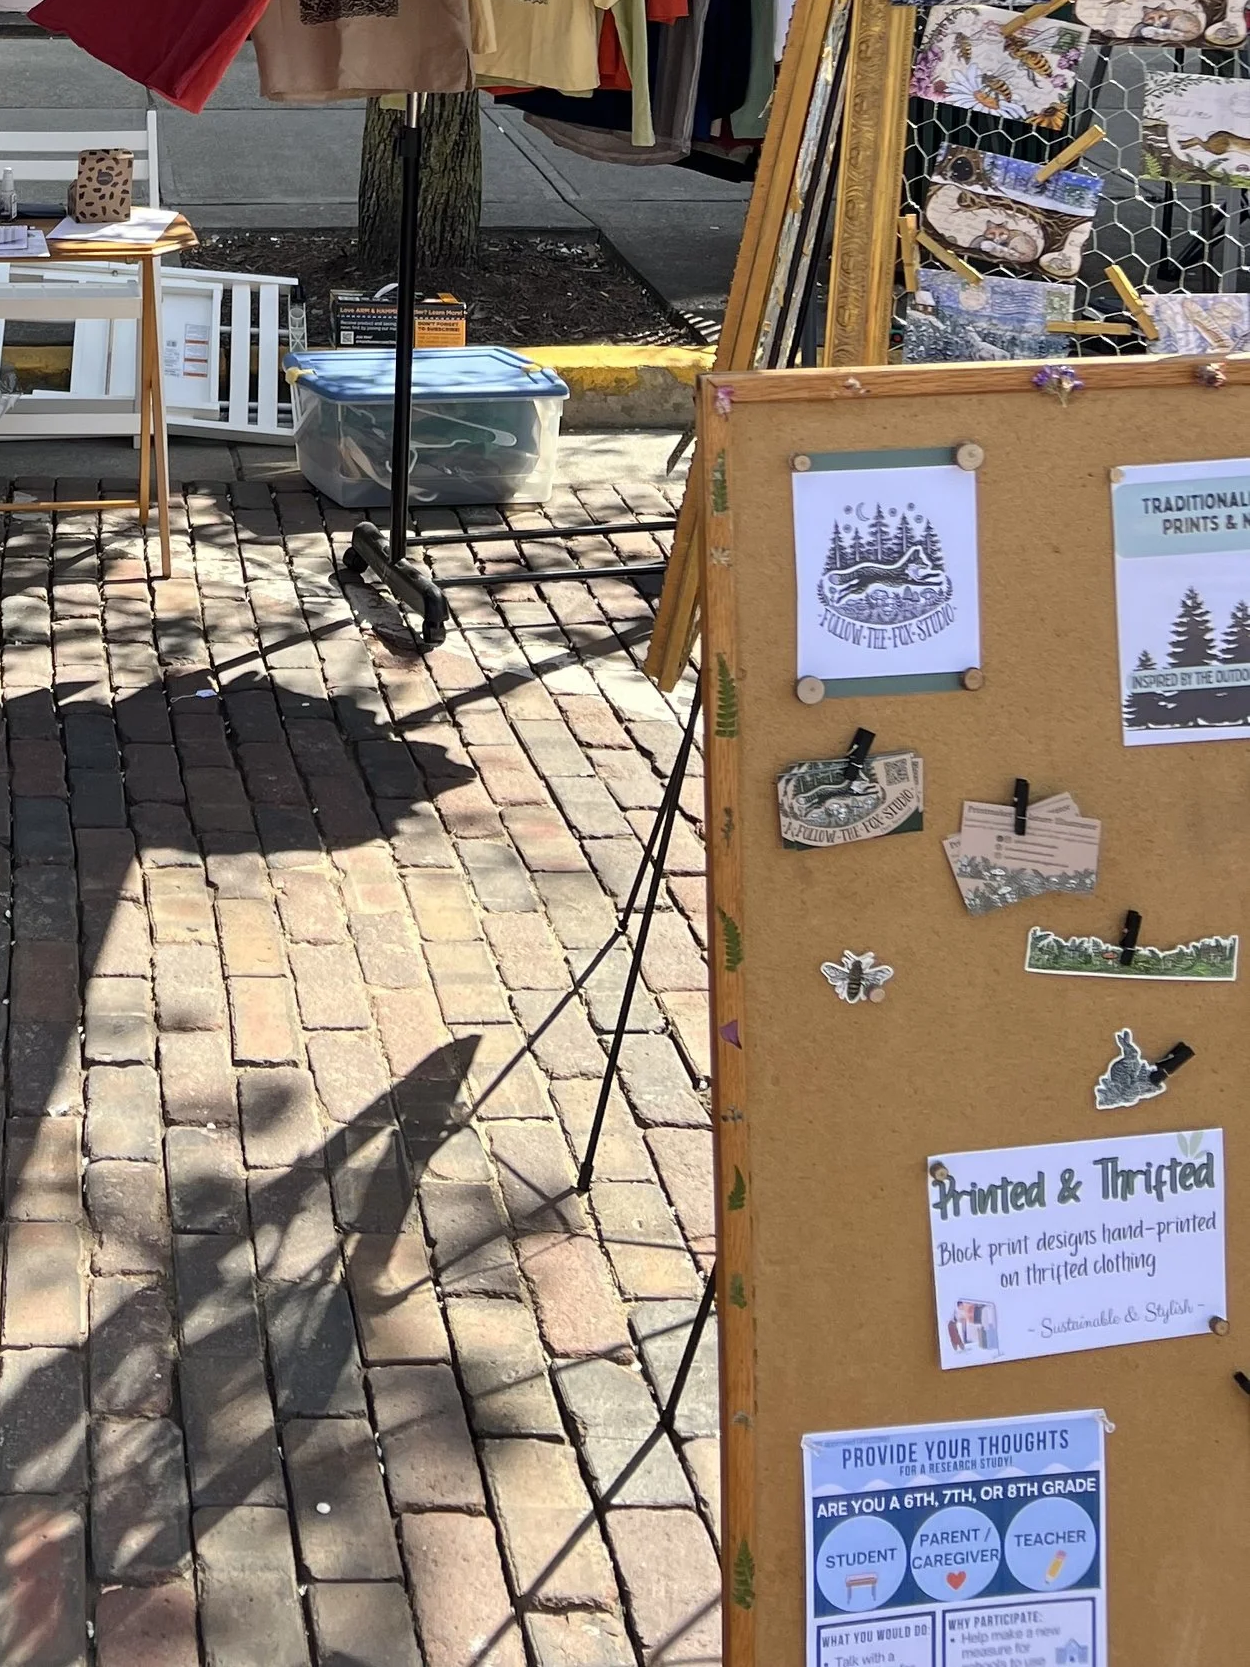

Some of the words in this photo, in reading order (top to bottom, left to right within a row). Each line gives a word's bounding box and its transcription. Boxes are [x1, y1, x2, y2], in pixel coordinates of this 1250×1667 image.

[1142, 491, 1250, 514] TRADITIONAL
[1162, 515, 1219, 534] PRINTS
[1226, 515, 1237, 530] &
[819, 607, 864, 646] FOLLOW
[866, 626, 887, 649] THE
[892, 622, 915, 648] FOX
[915, 603, 955, 642] STUDIO
[1132, 672, 1179, 689] INSPIRED
[1180, 672, 1193, 686] BY
[1194, 670, 1213, 684] THE
[1215, 667, 1250, 683] OUTDO
[795, 827, 836, 844] FOLLOW
[839, 827, 861, 841] THE
[861, 816, 885, 833] FOX
[882, 788, 915, 820] STUDIO
[932, 1171, 1047, 1221] Printed
[1057, 1168, 1083, 1205] &
[1093, 1151, 1216, 1203] Thrifted
[937, 1238, 982, 1267] Block
[988, 1234, 1031, 1265] print
[1036, 1229, 1097, 1257] designs
[1102, 1210, 1217, 1243] hand-printed
[1000, 1270, 1020, 1288] on
[1026, 1257, 1088, 1285] thrifted
[1093, 1251, 1157, 1277] clothing
[1040, 1305, 1121, 1338] Sustainable
[1124, 1304, 1140, 1322] &
[1144, 1298, 1193, 1324] Stylish
[842, 1442, 918, 1470] PROVIDE
[924, 1436, 972, 1462] YOUR
[978, 1428, 1070, 1455] THOUGHTS
[899, 1463, 917, 1477] FOR
[920, 1463, 926, 1474] A
[928, 1457, 977, 1474] RESEARCH
[980, 1454, 1013, 1468] STUDY!
[816, 1499, 848, 1519] ARE
[851, 1495, 886, 1514] YOU
[888, 1494, 901, 1510] A
[903, 1490, 939, 1510] 6TH,
[942, 1487, 977, 1506] 7TH,
[980, 1484, 1004, 1502] OR
[1007, 1481, 1038, 1498] 8TH
[1041, 1476, 1097, 1496] GRADE
[919, 1527, 980, 1547] PARENT
[1014, 1528, 1086, 1549] TEACHER
[825, 1547, 898, 1570] STUDENT
[911, 1548, 1000, 1571] CAREGIVER
[948, 1617, 971, 1631] WHY
[973, 1610, 1044, 1630] PARTICIPATE:
[822, 1634, 851, 1649] WHAT
[853, 1630, 874, 1645] YOU
[876, 1625, 911, 1641] WOULD
[961, 1632, 990, 1646] Help
[991, 1627, 1024, 1641] make
[1026, 1628, 1034, 1639] a
[1035, 1626, 1062, 1638] new
[835, 1654, 860, 1667] Talk
[861, 1652, 886, 1666] with
[887, 1652, 896, 1663] a
[961, 1644, 1014, 1660] measure
[1015, 1642, 1031, 1654] for
